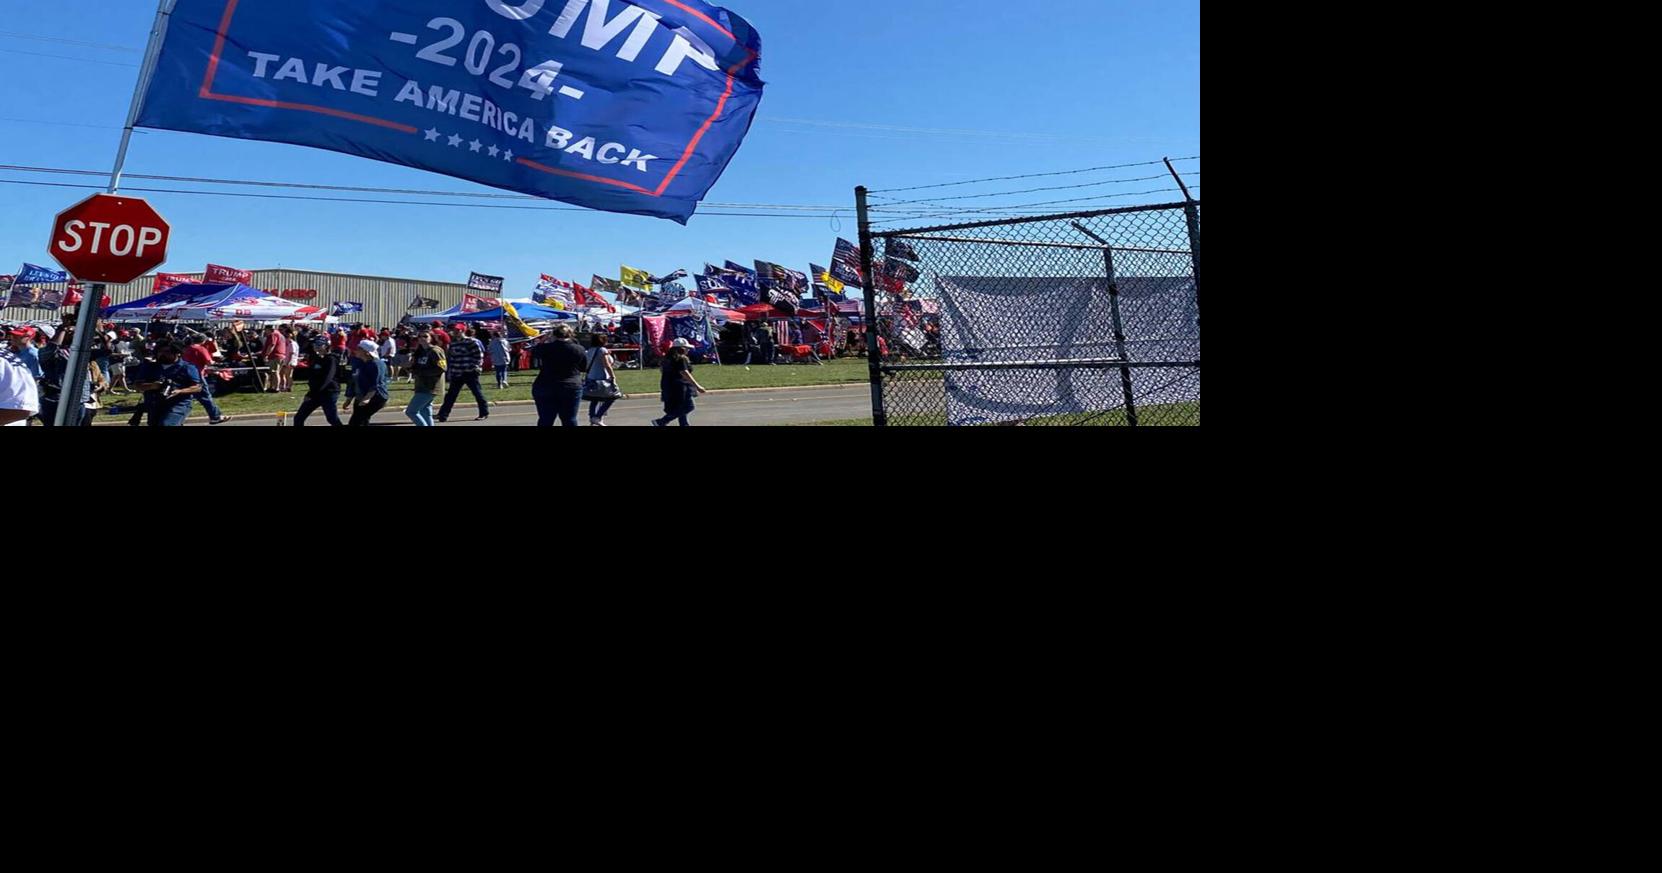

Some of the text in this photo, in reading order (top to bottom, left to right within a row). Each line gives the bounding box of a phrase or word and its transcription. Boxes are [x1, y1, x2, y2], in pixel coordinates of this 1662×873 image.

[247, 50, 660, 172] TAKE AMERICA BACK
[58, 220, 162, 257] STOP
[212, 267, 249, 279] TRUMP
[281, 287, 317, 299] AERO
